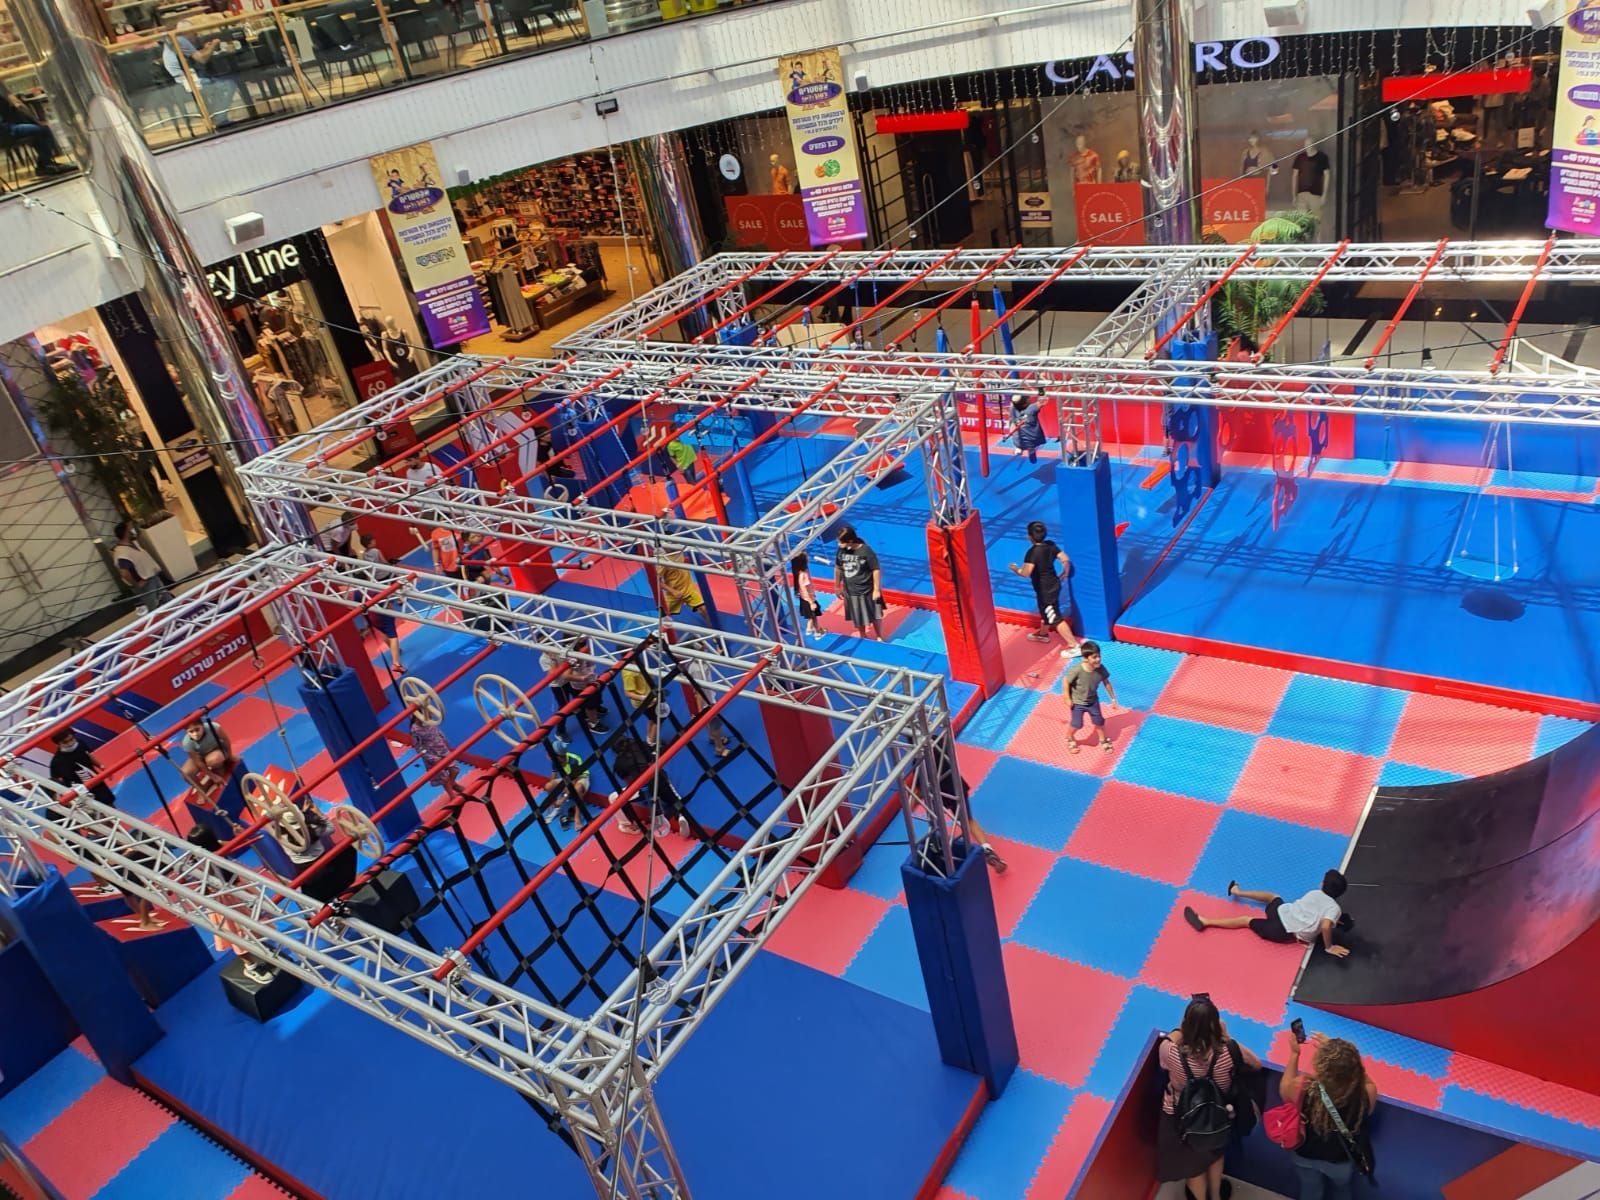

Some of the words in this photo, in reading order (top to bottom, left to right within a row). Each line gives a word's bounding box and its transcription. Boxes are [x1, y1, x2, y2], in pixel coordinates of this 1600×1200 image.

[1045, 36, 1280, 83] CARO
[1089, 212, 1123, 223] SALE
[1214, 210, 1250, 221] SALE
[739, 220, 763, 229] SALE
[780, 219, 805, 228] SALE
[240, 243, 300, 284] Line
[171, 655, 215, 689] שרונים
